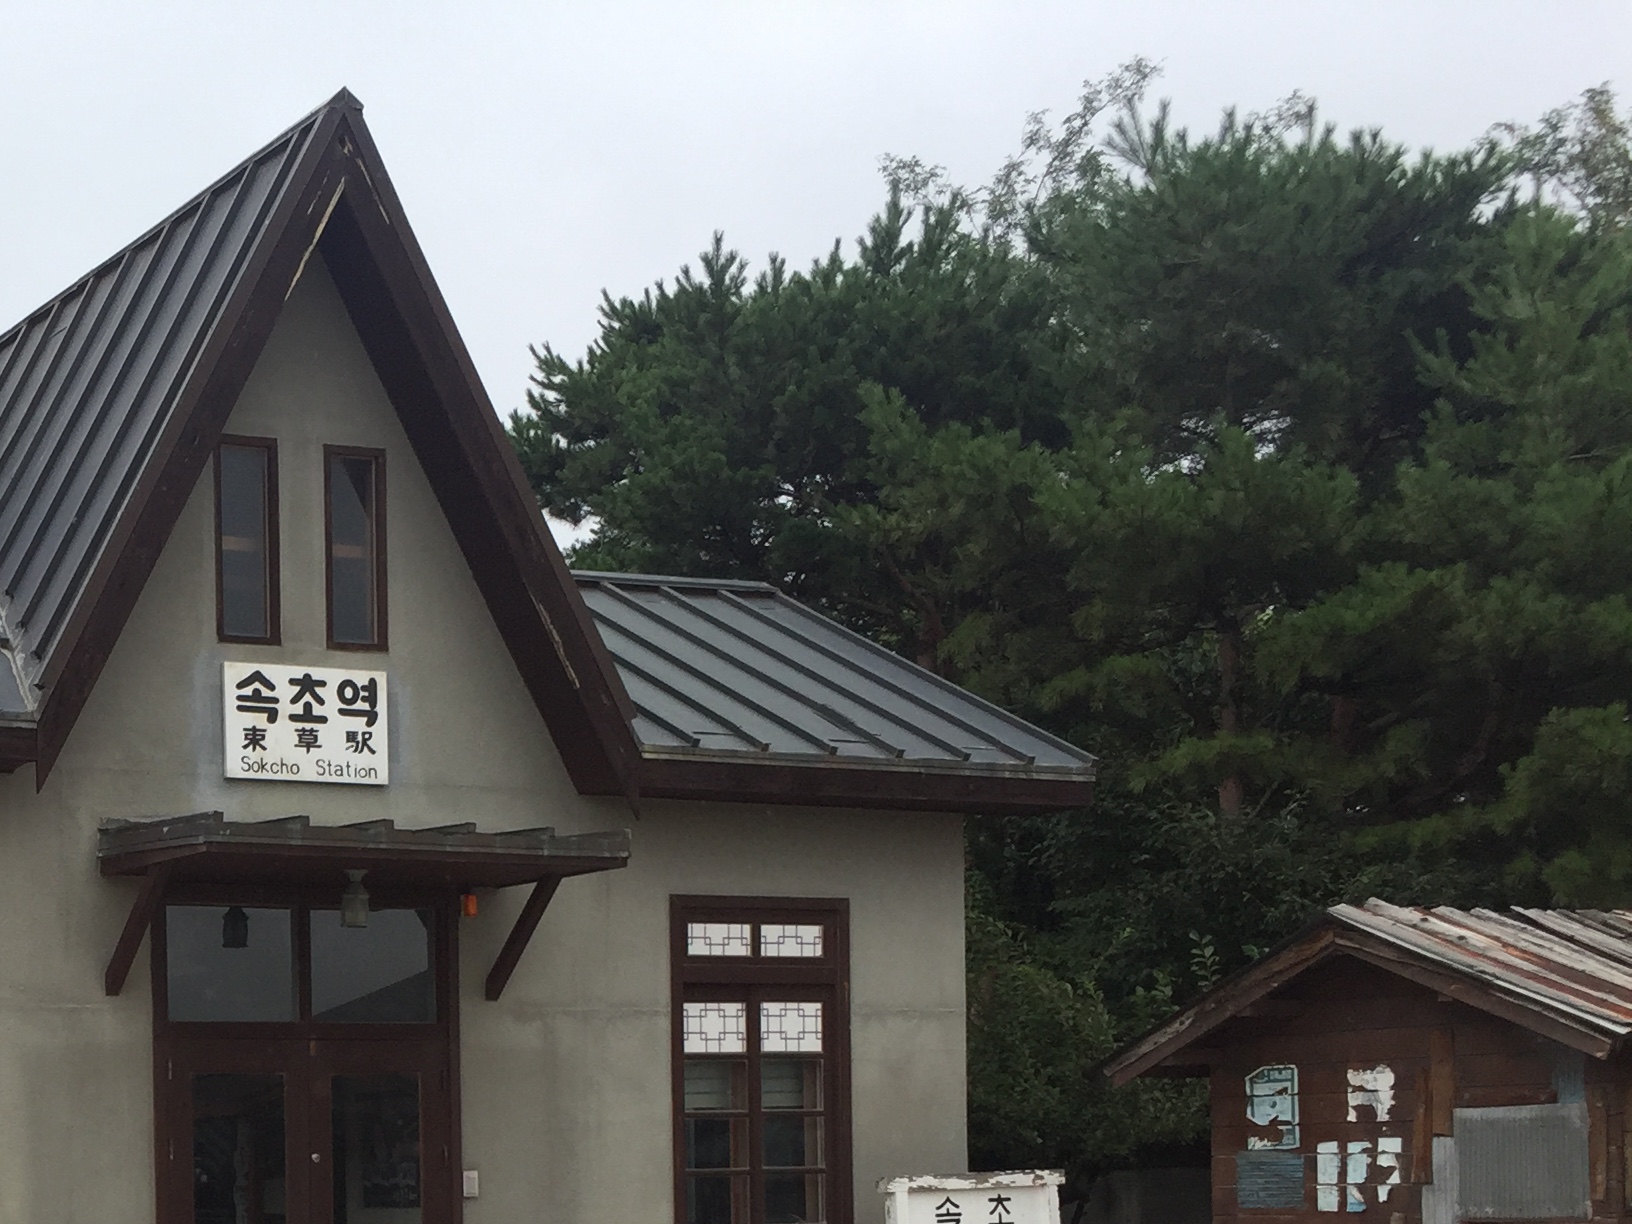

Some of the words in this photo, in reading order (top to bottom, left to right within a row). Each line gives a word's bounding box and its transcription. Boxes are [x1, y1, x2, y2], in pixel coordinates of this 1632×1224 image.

[235, 669, 379, 728] 속초역
[240, 755, 301, 776] Sokcho
[315, 758, 378, 780] Station
